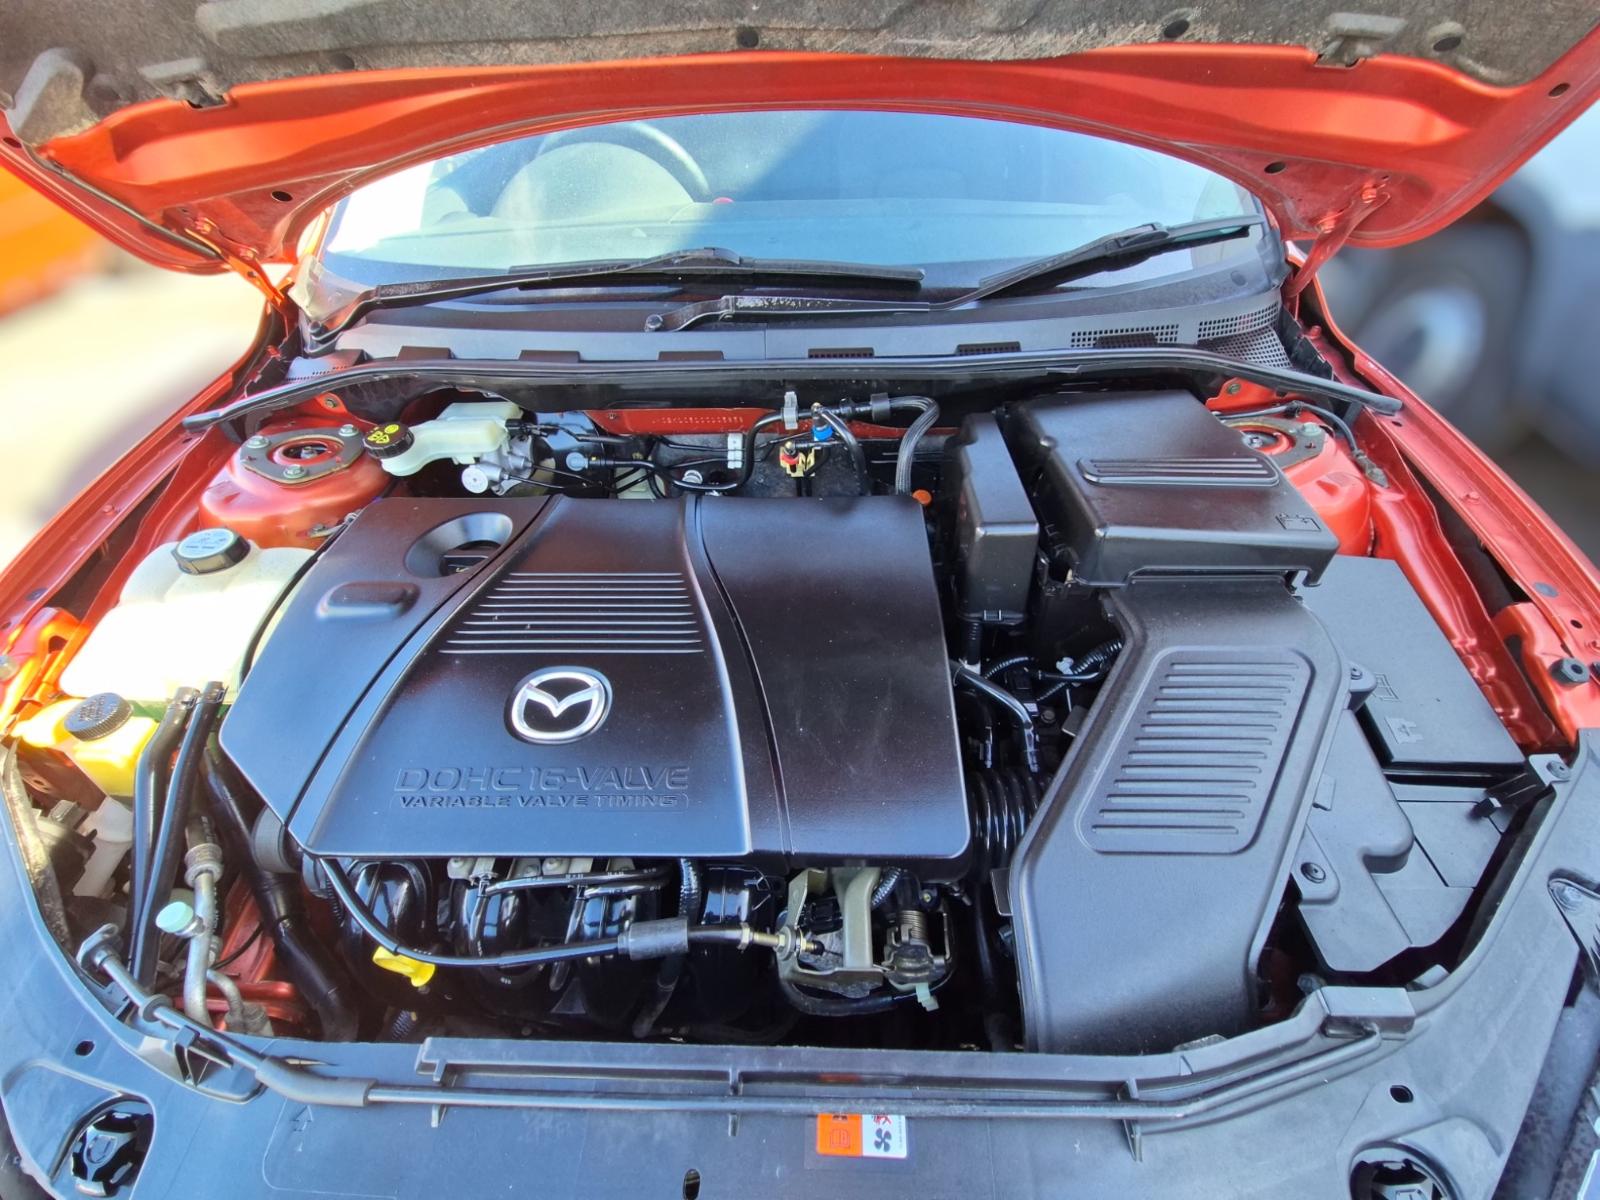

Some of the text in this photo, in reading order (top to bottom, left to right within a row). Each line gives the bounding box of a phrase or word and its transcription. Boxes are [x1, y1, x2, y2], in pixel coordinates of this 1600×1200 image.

[394, 766, 690, 791] DOHC 16-VALVE
[401, 794, 679, 808] VARIABLE VALVE TIMING
